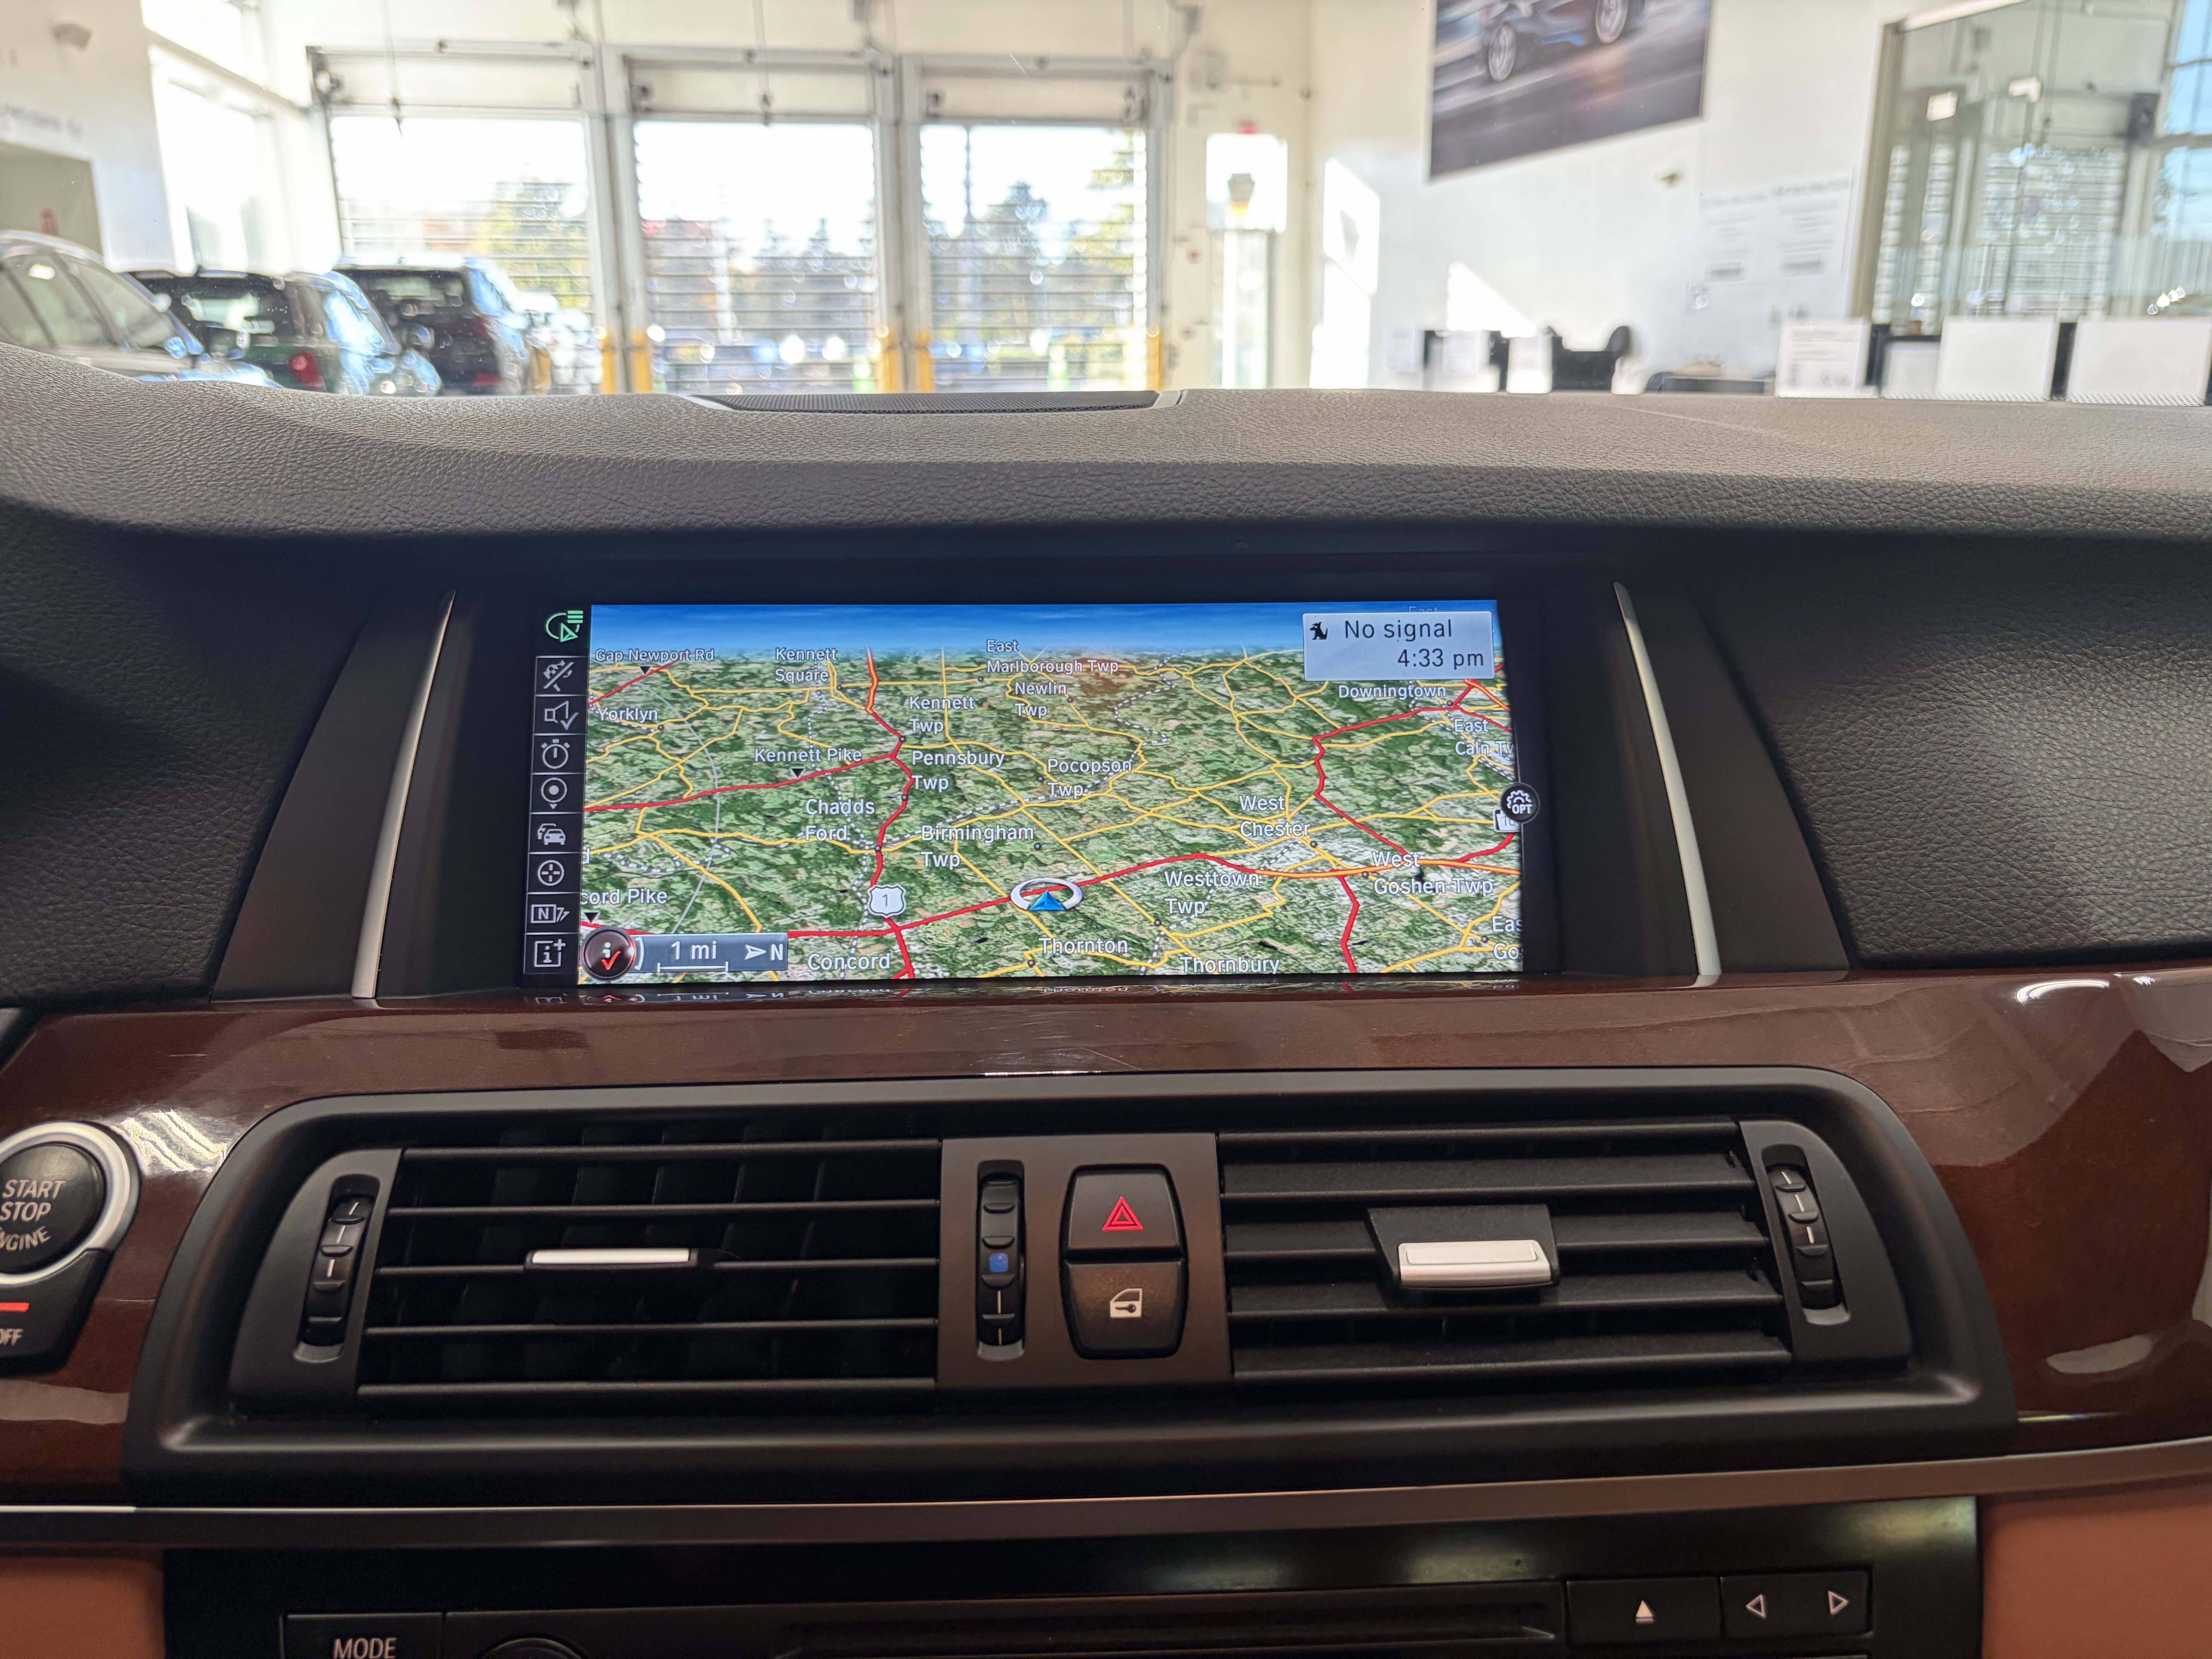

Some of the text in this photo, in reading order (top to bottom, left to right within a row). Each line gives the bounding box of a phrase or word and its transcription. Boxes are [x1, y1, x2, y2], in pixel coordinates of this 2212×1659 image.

[1345, 619, 1452, 642] No signal
[987, 640, 1018, 652] East
[596, 649, 714, 664] Gap Newport Rd
[776, 649, 837, 661] Kennett
[1397, 648, 1484, 670] 4:33 pm
[987, 660, 1119, 673] Marlborough Twp
[775, 669, 829, 683] Square
[1015, 683, 1067, 695] Newlin
[1339, 685, 1446, 700] Downingtown
[910, 697, 974, 709] Kennett
[599, 708, 658, 723] Yorklyn
[1015, 704, 1047, 718] Twp
[910, 719, 943, 733] Twp
[1455, 719, 1489, 732] East
[755, 748, 862, 762] Kennett Pike
[1455, 741, 1489, 755] Caln
[912, 751, 1005, 767] Pennsbury
[1048, 759, 1132, 774] Pocopson
[914, 776, 949, 791] Twp
[1048, 782, 1084, 797] Twp
[806, 799, 875, 814] Chadds
[1240, 796, 1285, 811] West
[1512, 804, 1532, 814] OPT
[805, 826, 847, 840] Ford
[922, 826, 1034, 843] Birmingham
[1240, 822, 1310, 837] Chester
[921, 852, 960, 869] Twp
[1373, 852, 1420, 867] West
[1165, 871, 1259, 887] Westtown
[1374, 878, 1493, 895] Goshen Twp
[628, 888, 668, 904] Pike
[882, 894, 889, 907] 1
[1165, 898, 1206, 916] Twp
[671, 941, 717, 960] 1 mi
[770, 944, 783, 961] N
[1039, 938, 1128, 954] Thornton
[808, 953, 891, 970] Concord
[1180, 957, 1279, 974] Thornbury
[2, 1180, 66, 1199] START
[0, 1202, 51, 1221] STOP
[333, 1638, 397, 1659] MODE
